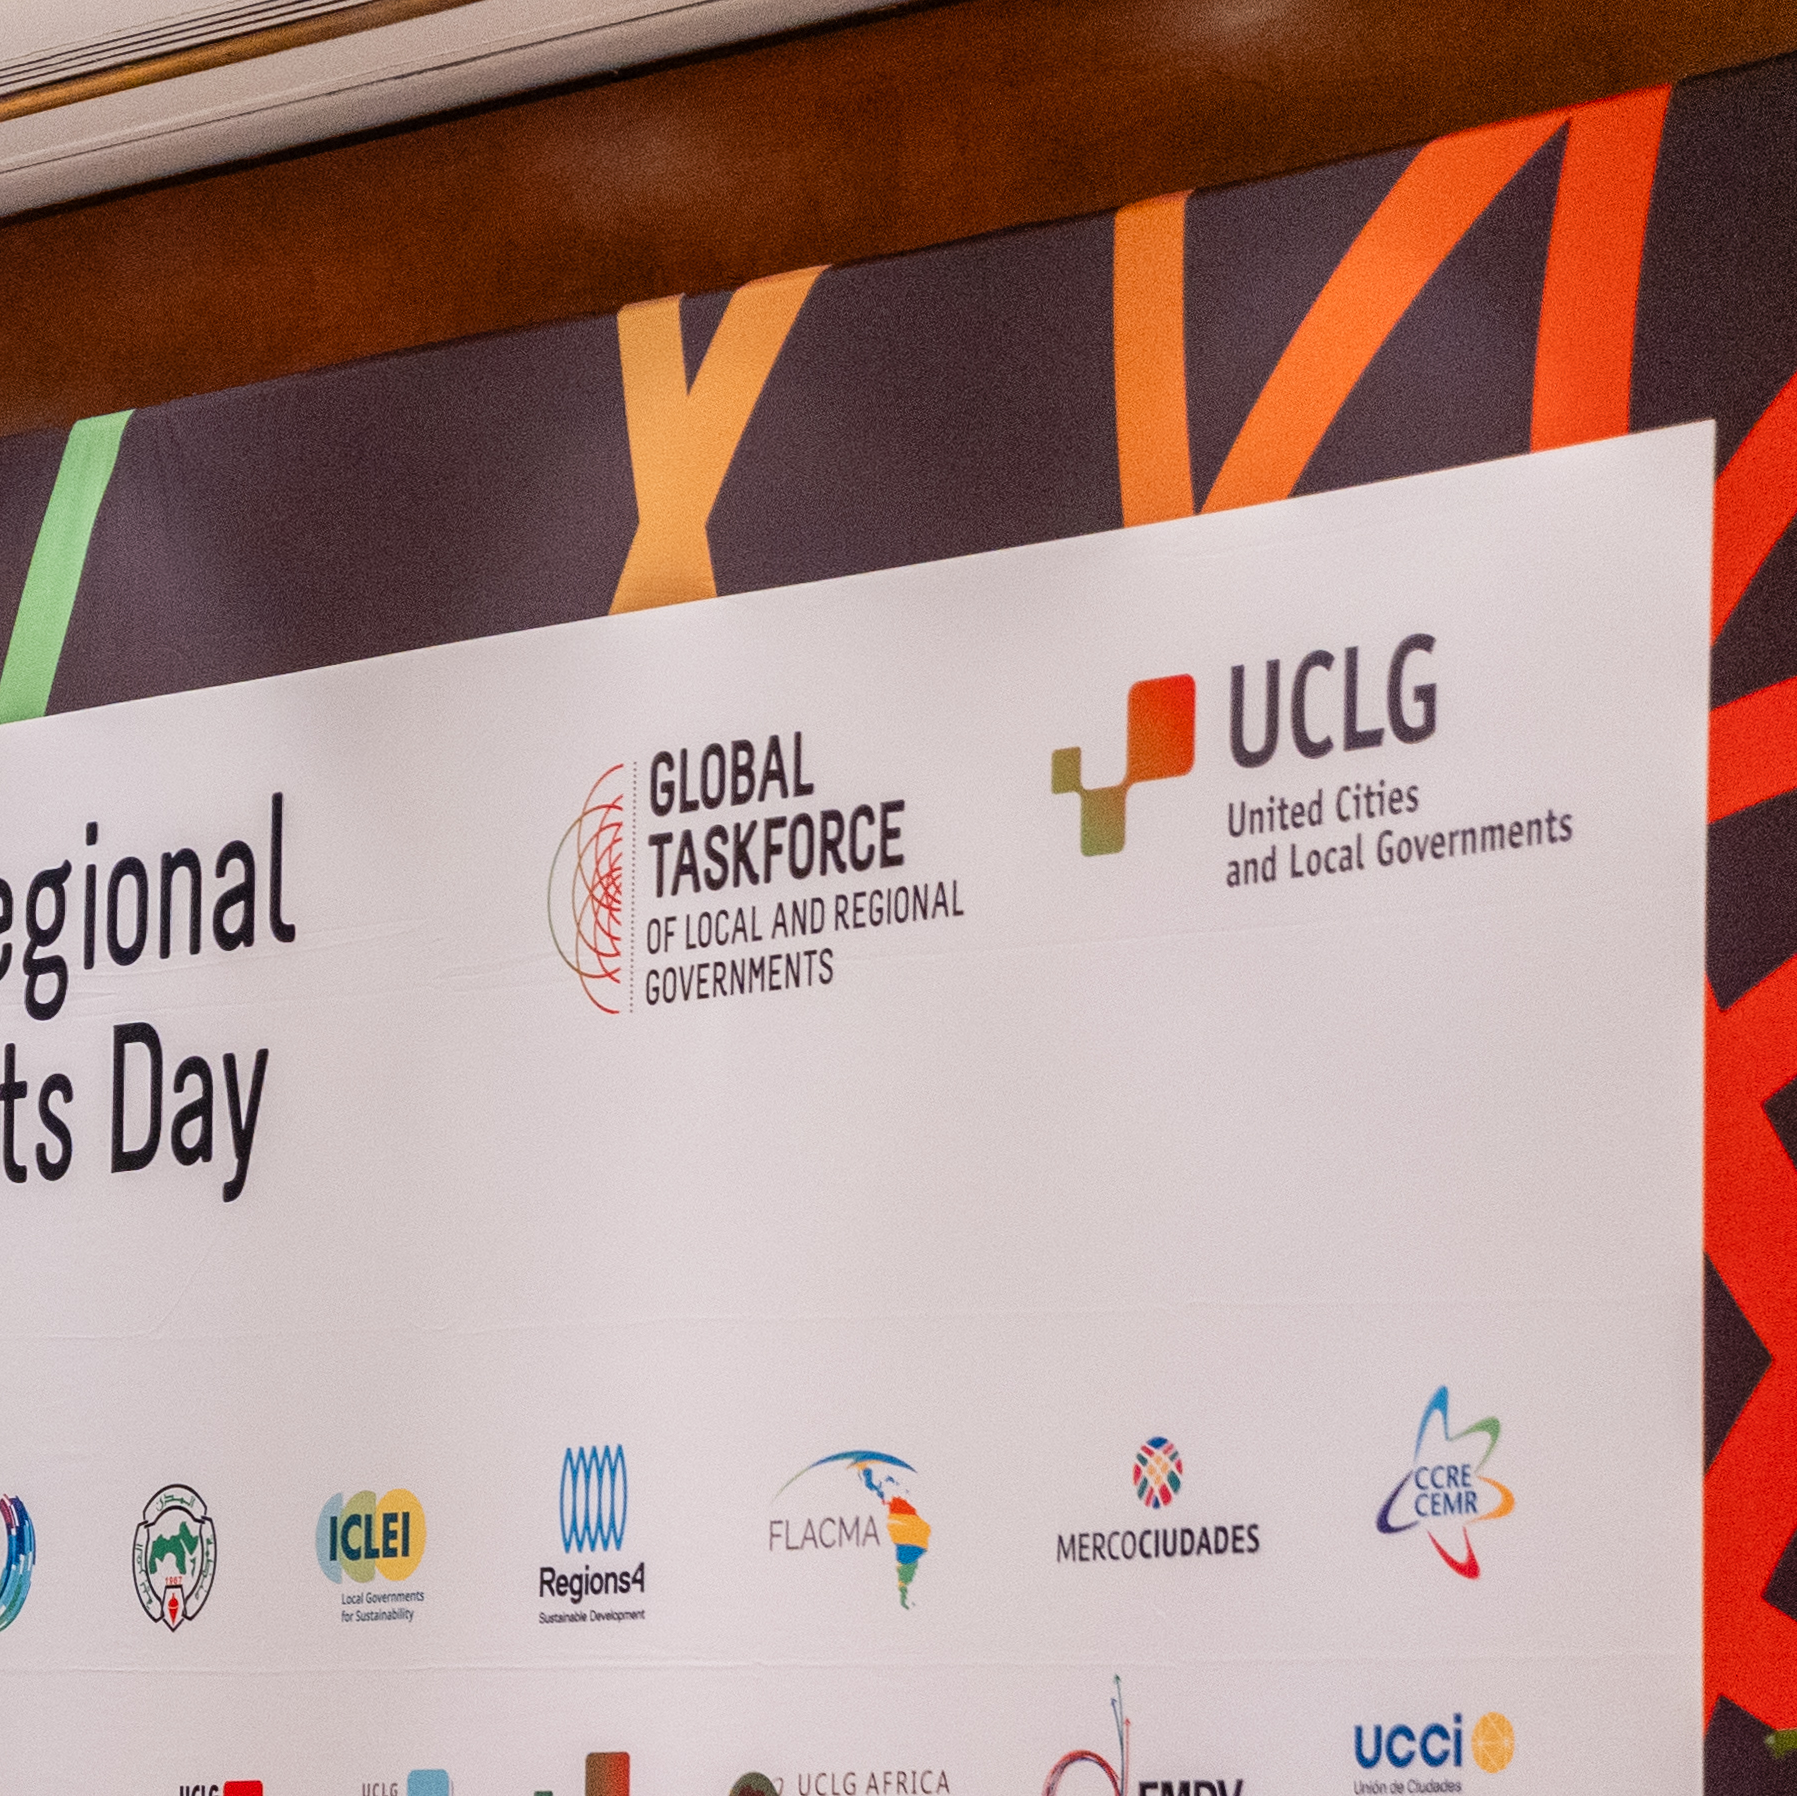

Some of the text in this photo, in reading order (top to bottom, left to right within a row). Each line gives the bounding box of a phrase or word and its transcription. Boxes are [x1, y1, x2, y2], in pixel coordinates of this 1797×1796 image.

[1228, 632, 1438, 769] UCLG
[649, 731, 814, 817] GLOBAL
[1227, 779, 1419, 838] United Cities
[648, 798, 906, 899] TASKFORCE
[1226, 808, 1573, 888] and Local Governments
[646, 879, 965, 956] OF LOCAL AND REGIONAL
[645, 947, 835, 1006] GOVERNMENTS
[111, 1021, 268, 1202] Day
[1414, 1463, 1472, 1491] CCRE
[1414, 1489, 1479, 1518] CEMR
[330, 1511, 410, 1561] ICLEI
[769, 1514, 880, 1552] FLACMA
[1056, 1523, 1261, 1565] MERCOCIUDADES
[341, 1591, 425, 1605] Local Governments
[539, 1561, 645, 1604] Regions4
[341, 1608, 414, 1622] for Sustainability
[539, 1609, 645, 1624] Sustainable Development
[798, 1770, 950, 1796] UCLG AFRICA
[1354, 1779, 1462, 1795] Unión de Ciudades
